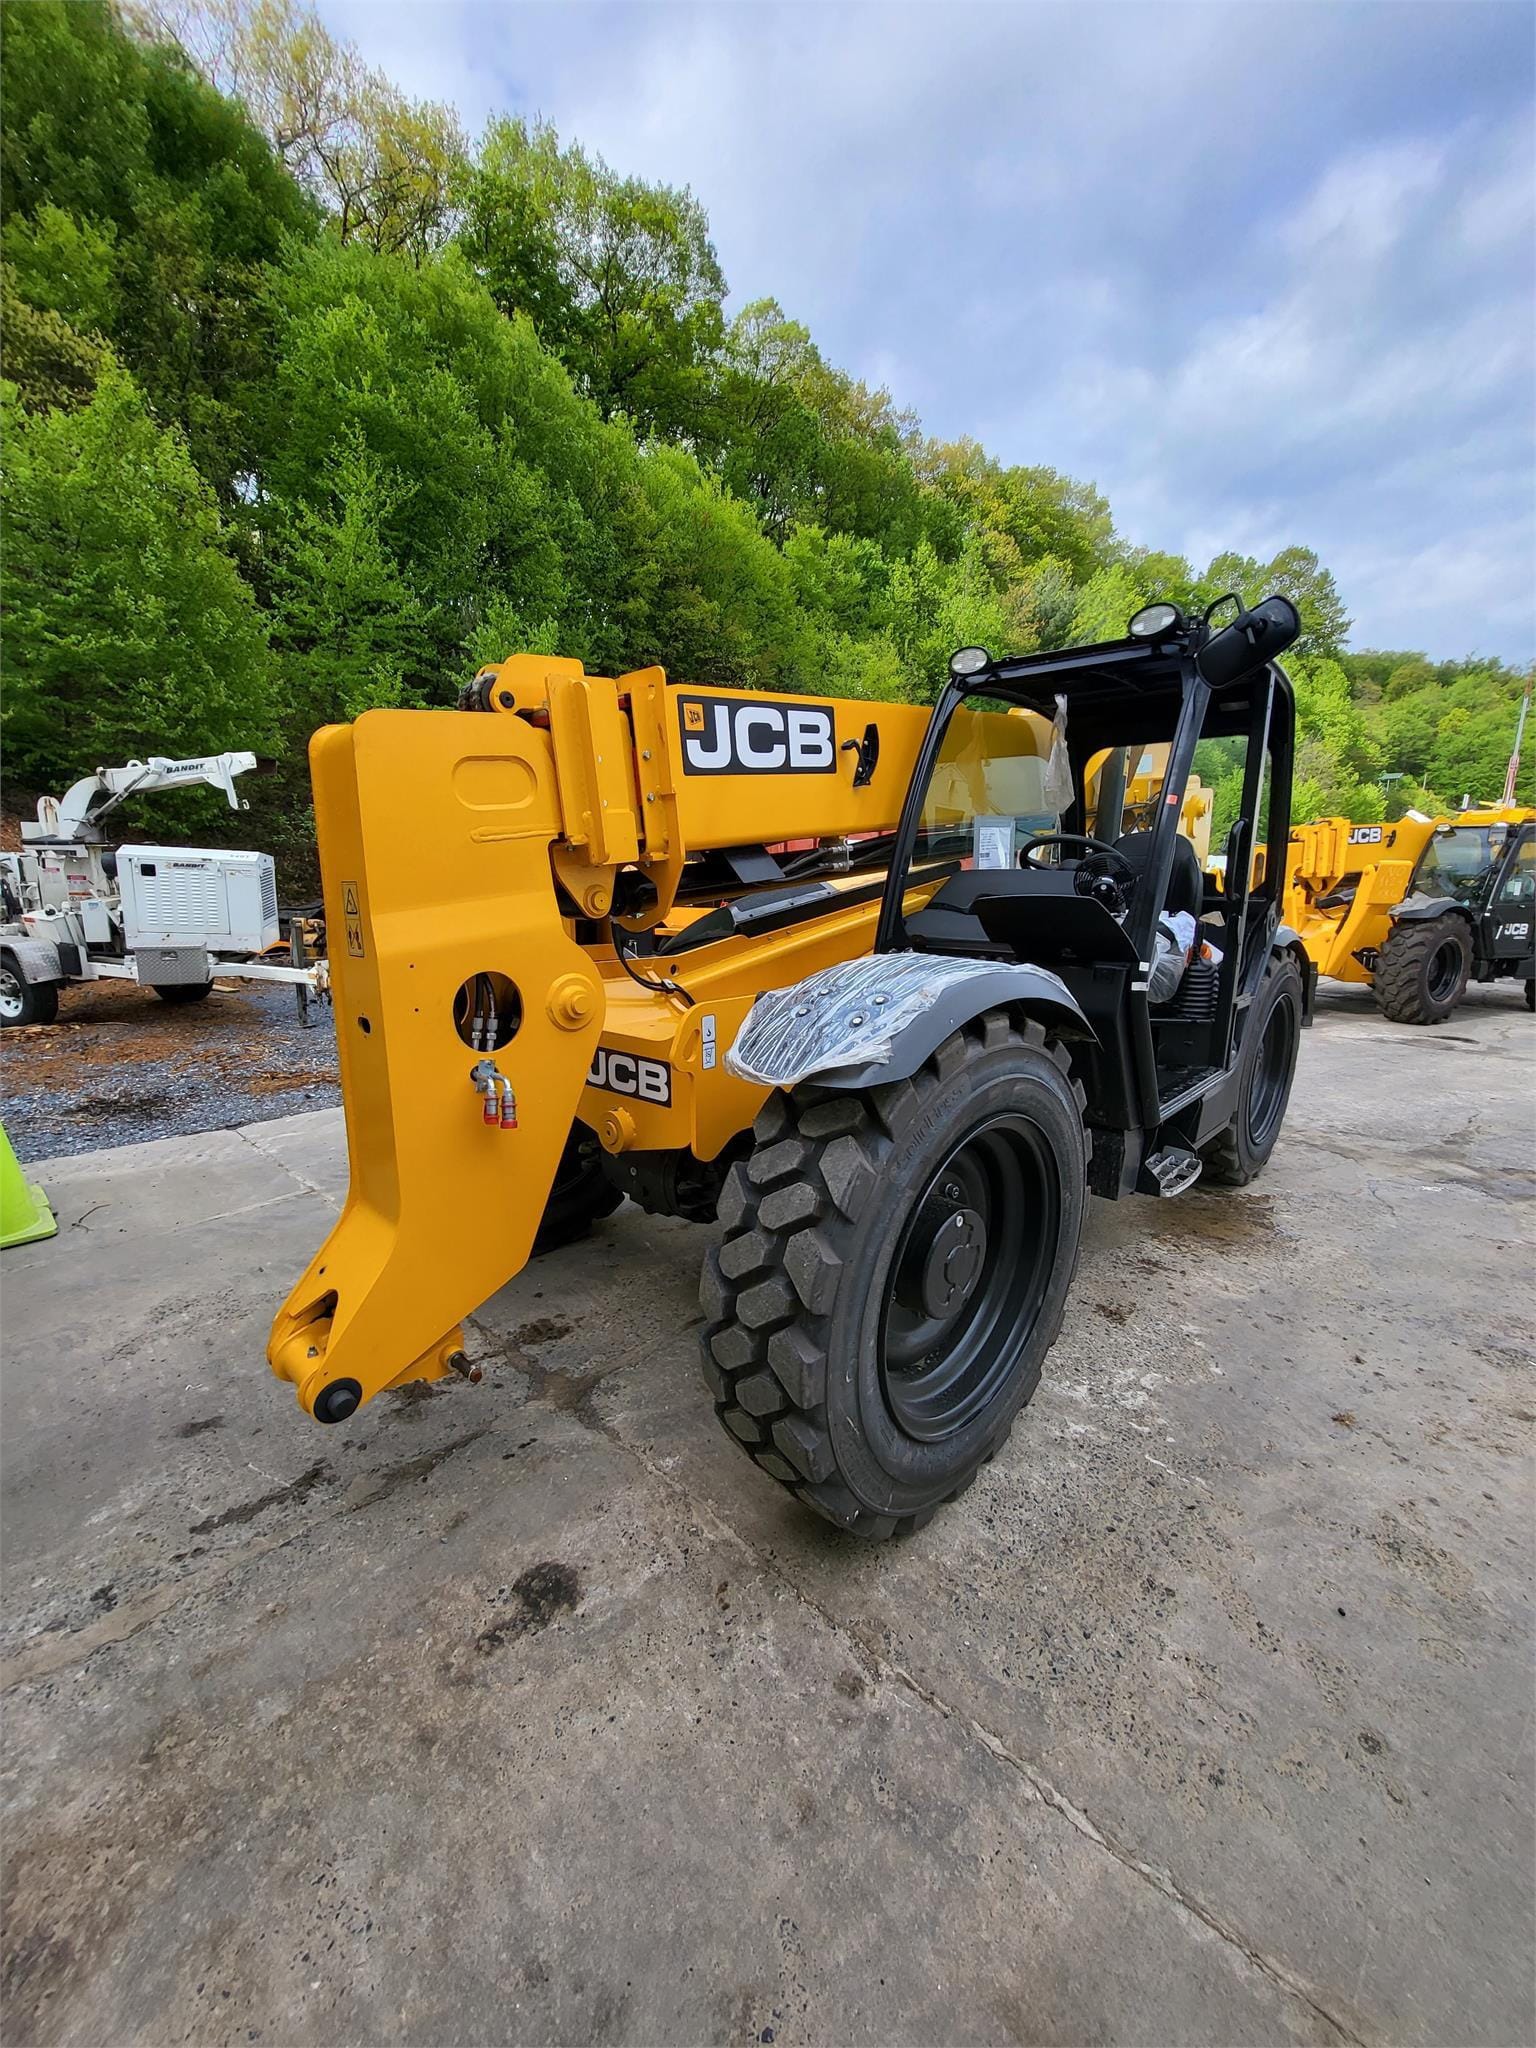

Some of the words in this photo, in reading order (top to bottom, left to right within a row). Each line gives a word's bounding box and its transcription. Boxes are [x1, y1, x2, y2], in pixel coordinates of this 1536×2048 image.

[686, 705, 833, 769] JCB
[166, 762, 206, 774] BANDIT
[1347, 828, 1382, 844] JCB
[1503, 923, 1529, 935] JCB
[587, 1050, 669, 1102] JCB
